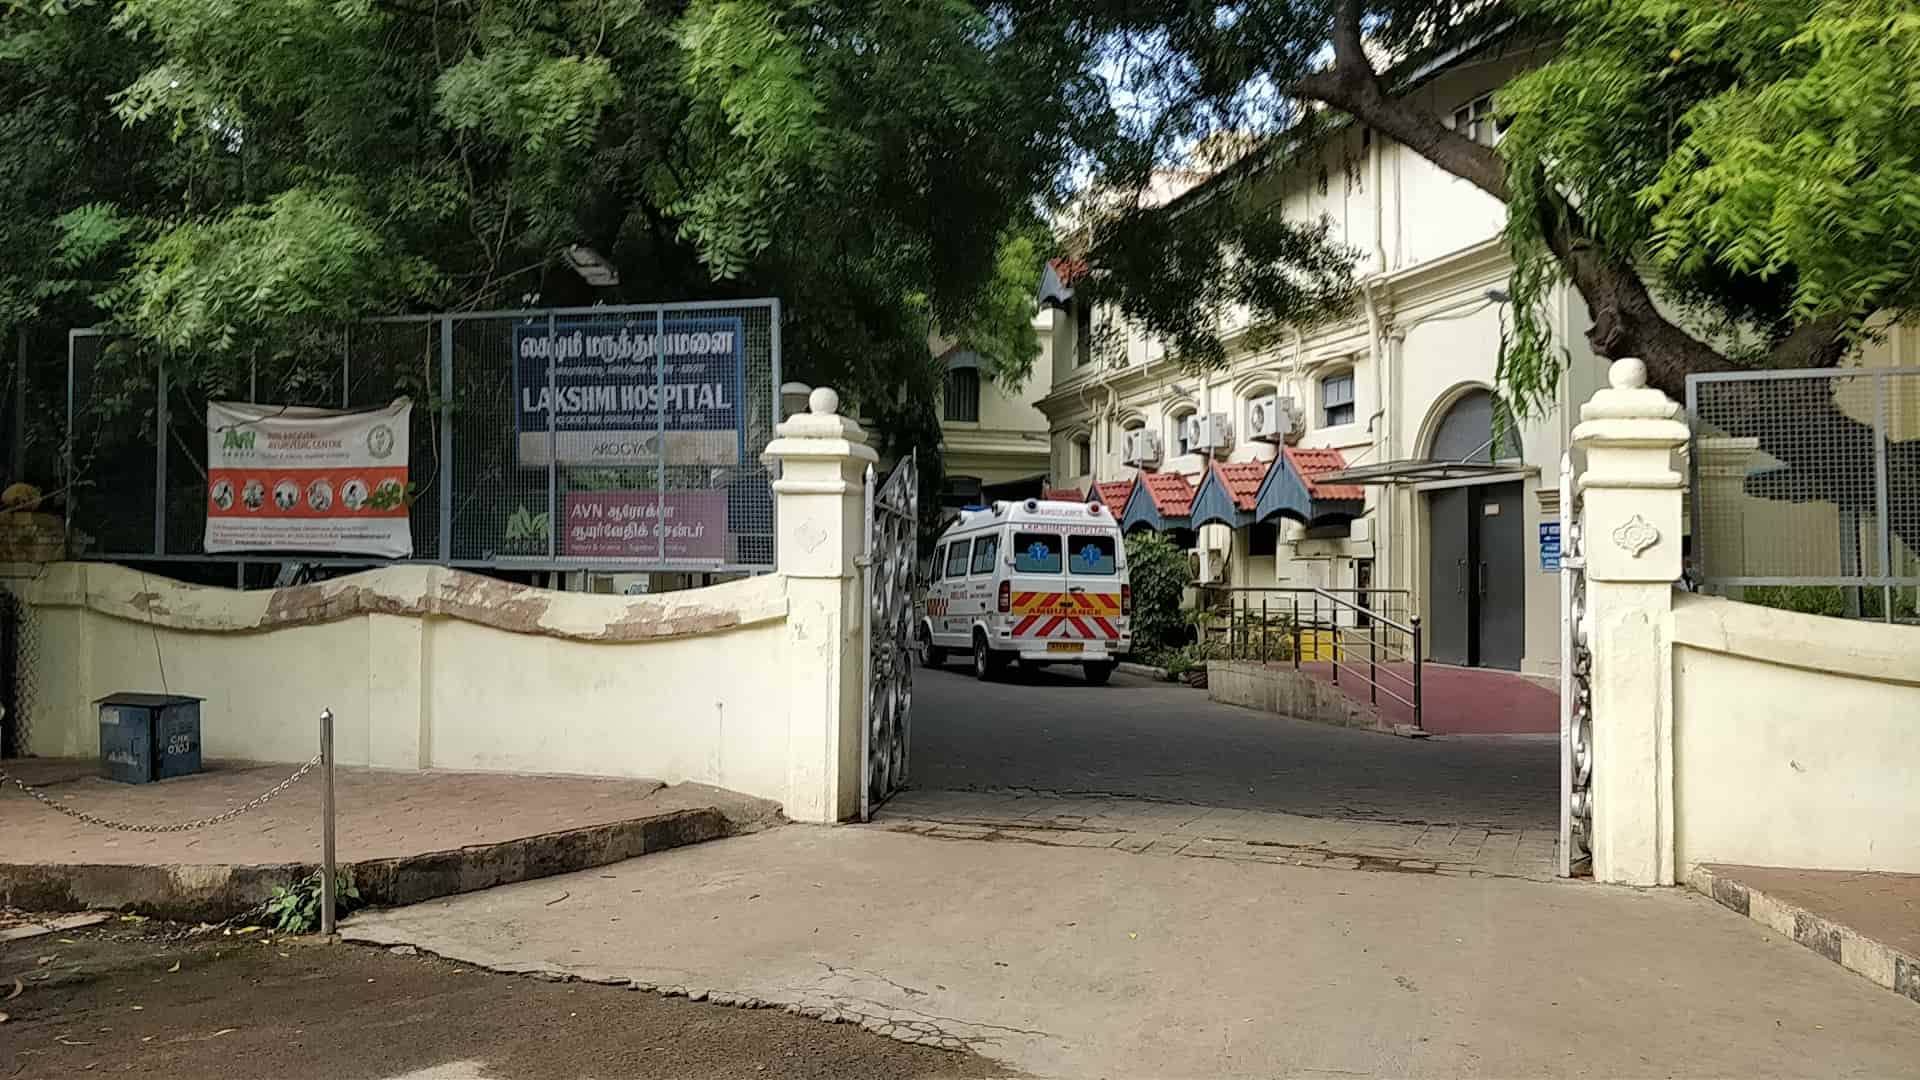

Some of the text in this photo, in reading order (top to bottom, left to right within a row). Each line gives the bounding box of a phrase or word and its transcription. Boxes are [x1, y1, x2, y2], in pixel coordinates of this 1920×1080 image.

[522, 383, 733, 412] LAKSHMI HOSPITAL
[571, 503, 603, 518] AVN
[1028, 606, 1103, 615] AMBULANCE
